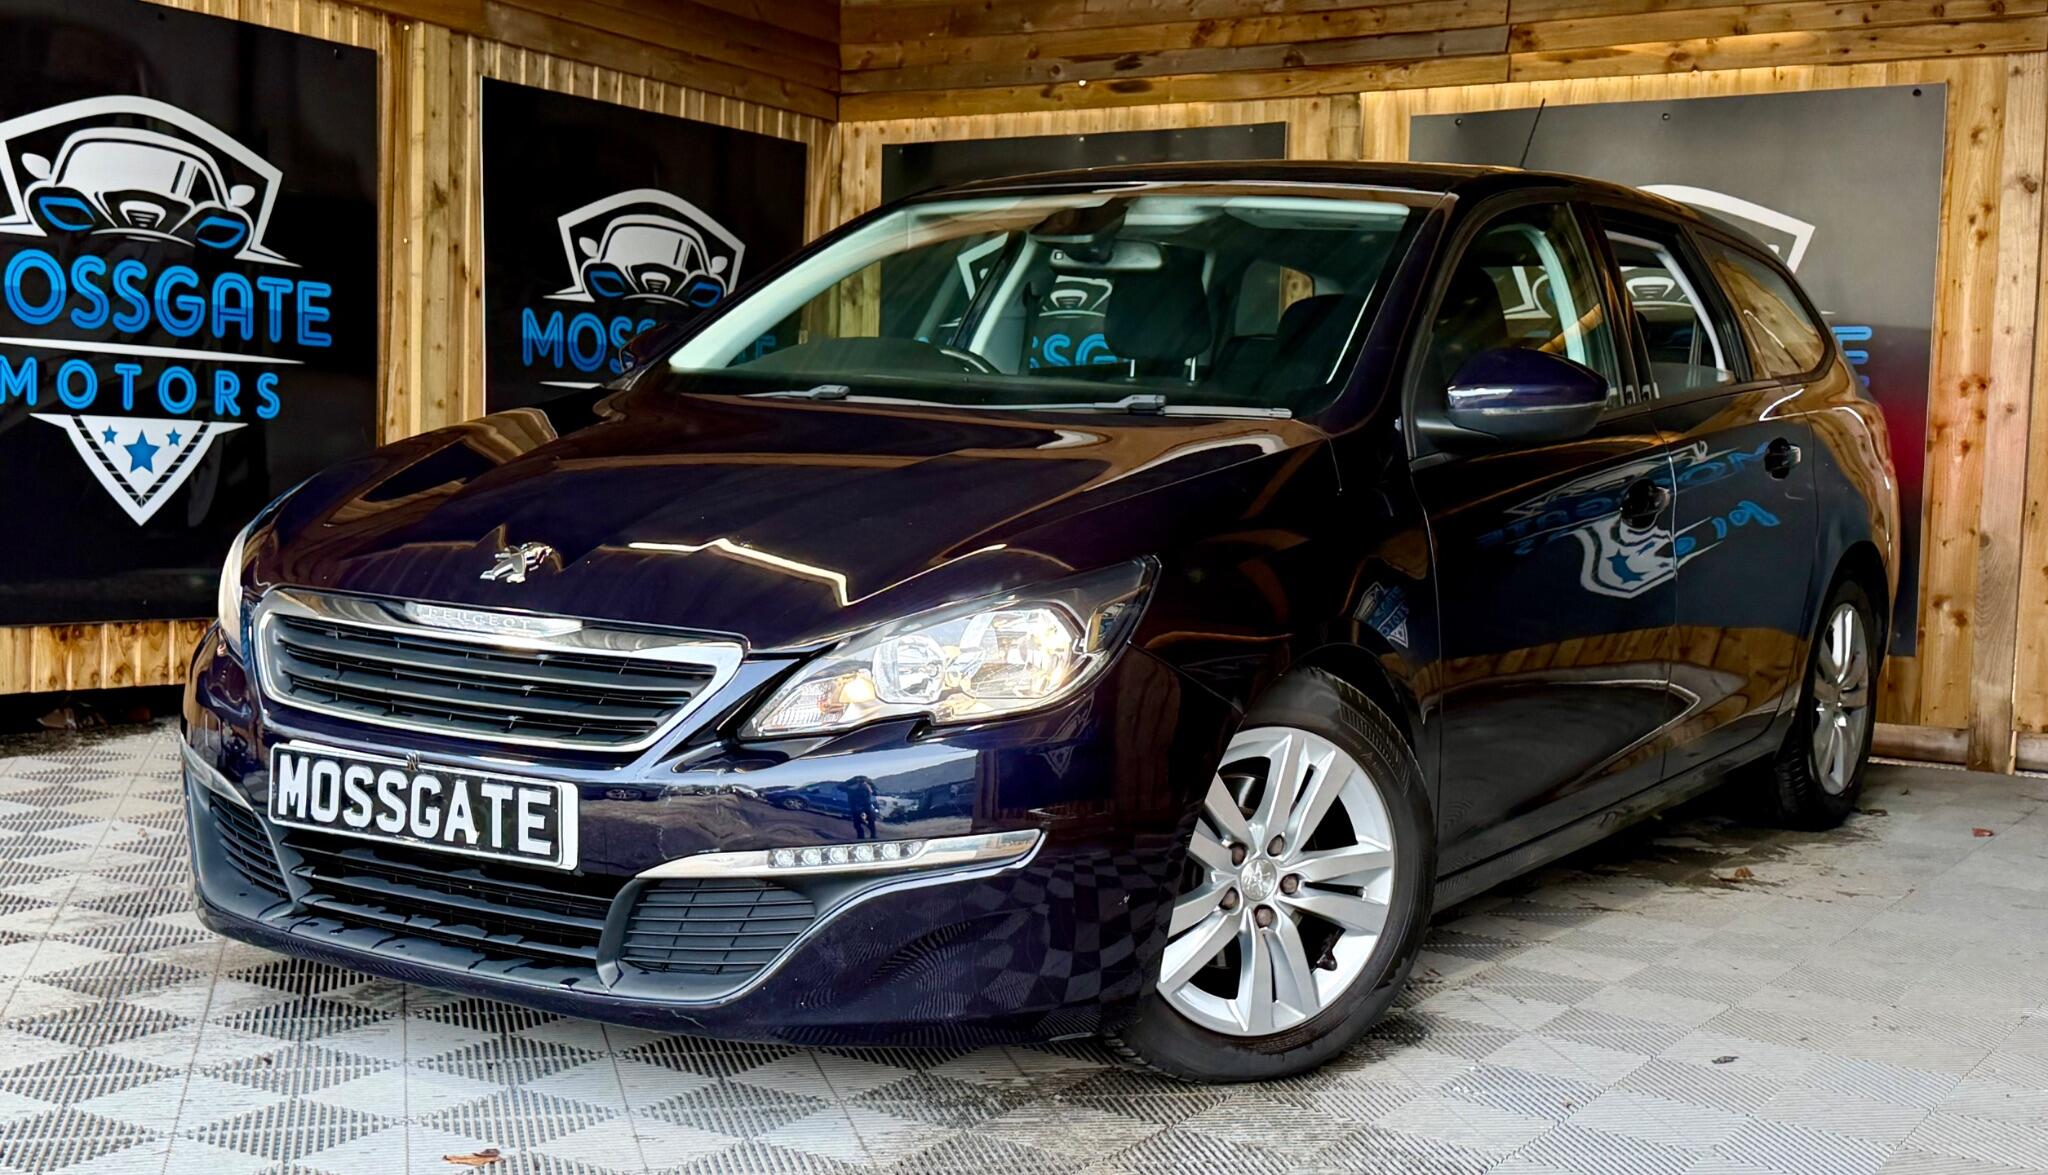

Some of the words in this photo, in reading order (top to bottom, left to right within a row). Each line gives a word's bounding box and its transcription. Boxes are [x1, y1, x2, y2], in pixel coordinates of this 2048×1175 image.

[4, 248, 332, 347] OSSGATE
[0, 355, 280, 420] MOTORS
[427, 607, 532, 631] PEUGEOT
[277, 753, 552, 856] MOSSGATE
